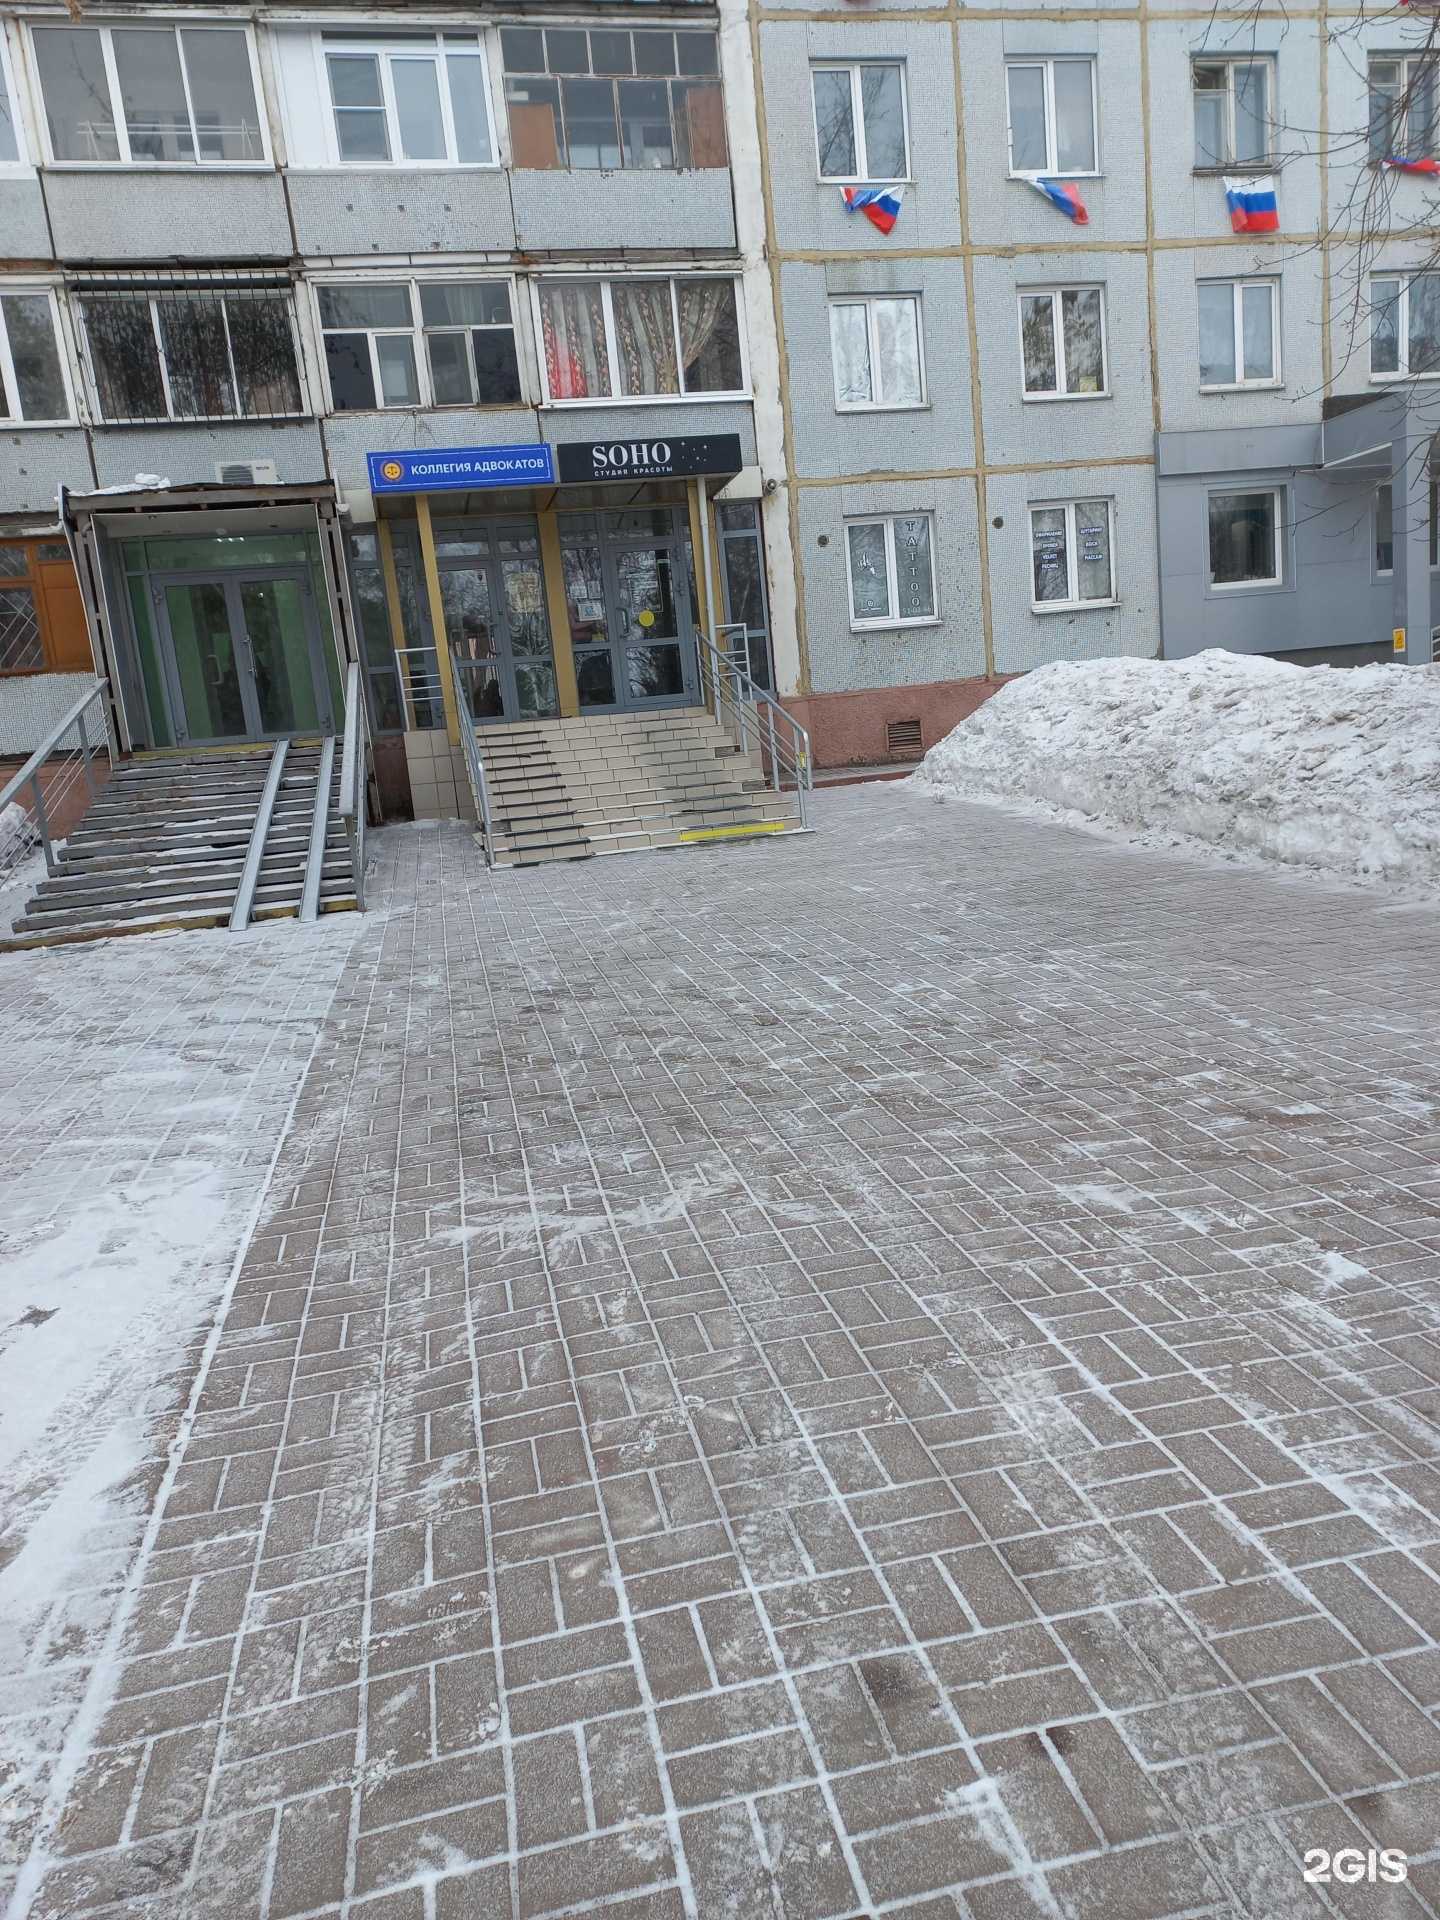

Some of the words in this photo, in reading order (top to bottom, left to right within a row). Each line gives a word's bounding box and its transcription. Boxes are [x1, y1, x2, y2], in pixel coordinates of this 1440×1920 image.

[592, 441, 671, 468] SOHO
[411, 462, 472, 475] КОЛЛЕГИЯ
[474, 458, 544, 472] АДВОКАТОВ
[594, 469, 628, 477] СТУДИЯ
[633, 466, 673, 475] КРАСОТЫ
[905, 521, 920, 606] TATTOO
